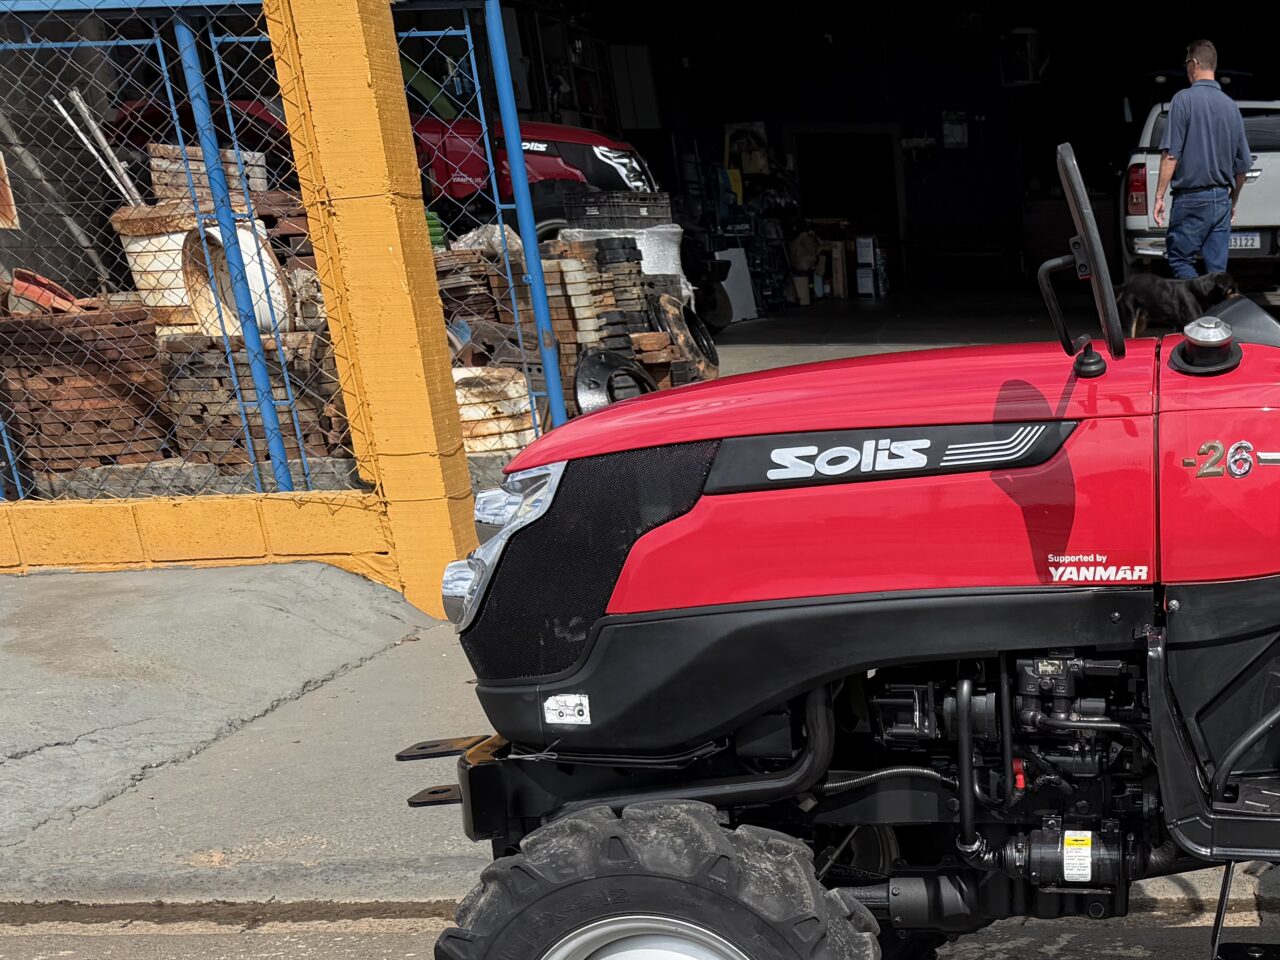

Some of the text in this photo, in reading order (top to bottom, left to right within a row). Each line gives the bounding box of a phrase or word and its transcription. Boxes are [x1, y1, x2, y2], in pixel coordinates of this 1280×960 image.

[1047, 553, 1107, 564] Supported by
[1048, 565, 1149, 582] YANMAR
